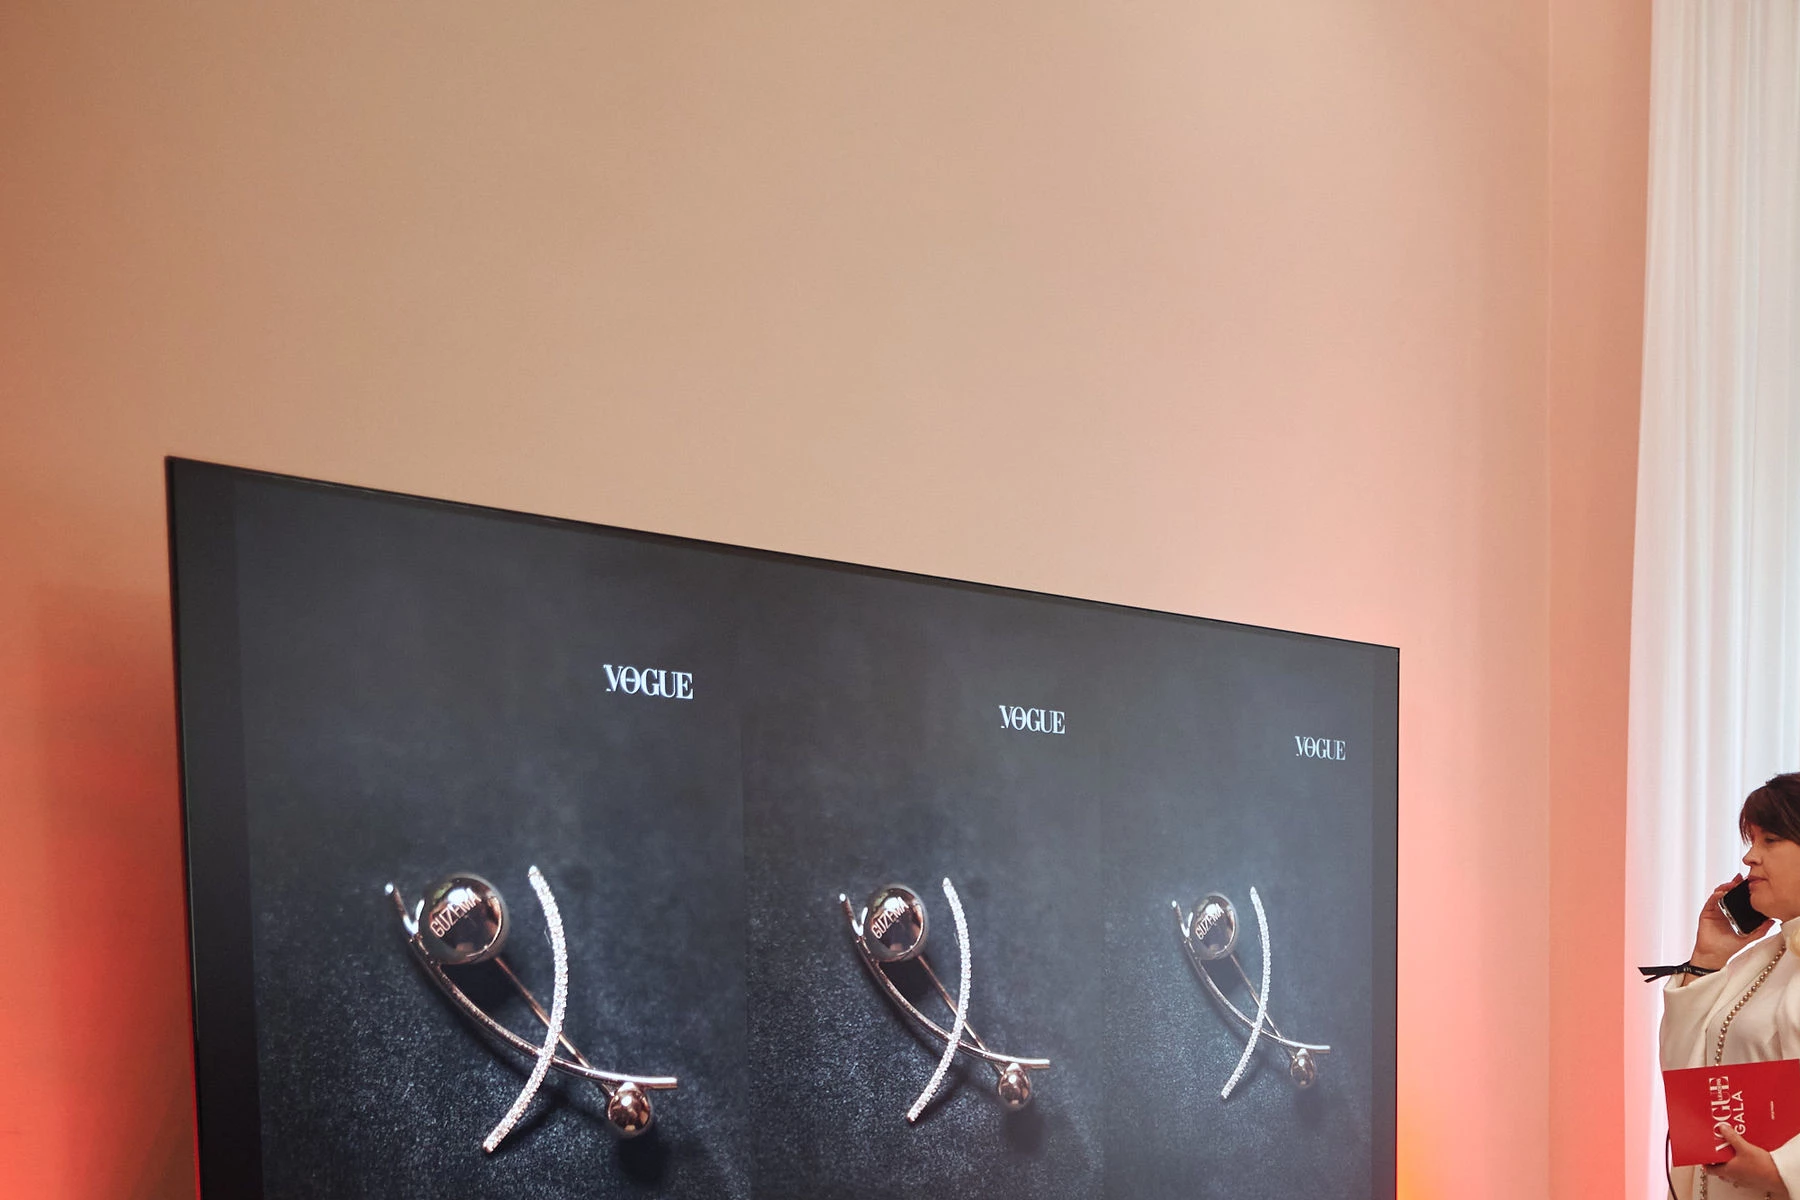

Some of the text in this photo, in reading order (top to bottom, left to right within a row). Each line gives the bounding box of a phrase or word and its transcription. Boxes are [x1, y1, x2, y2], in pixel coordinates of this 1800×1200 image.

[603, 664, 693, 700] VOGUE
[999, 705, 1066, 735] VOGUE
[1295, 736, 1346, 761] VOGUE
[1732, 1090, 1746, 1135] GALA
